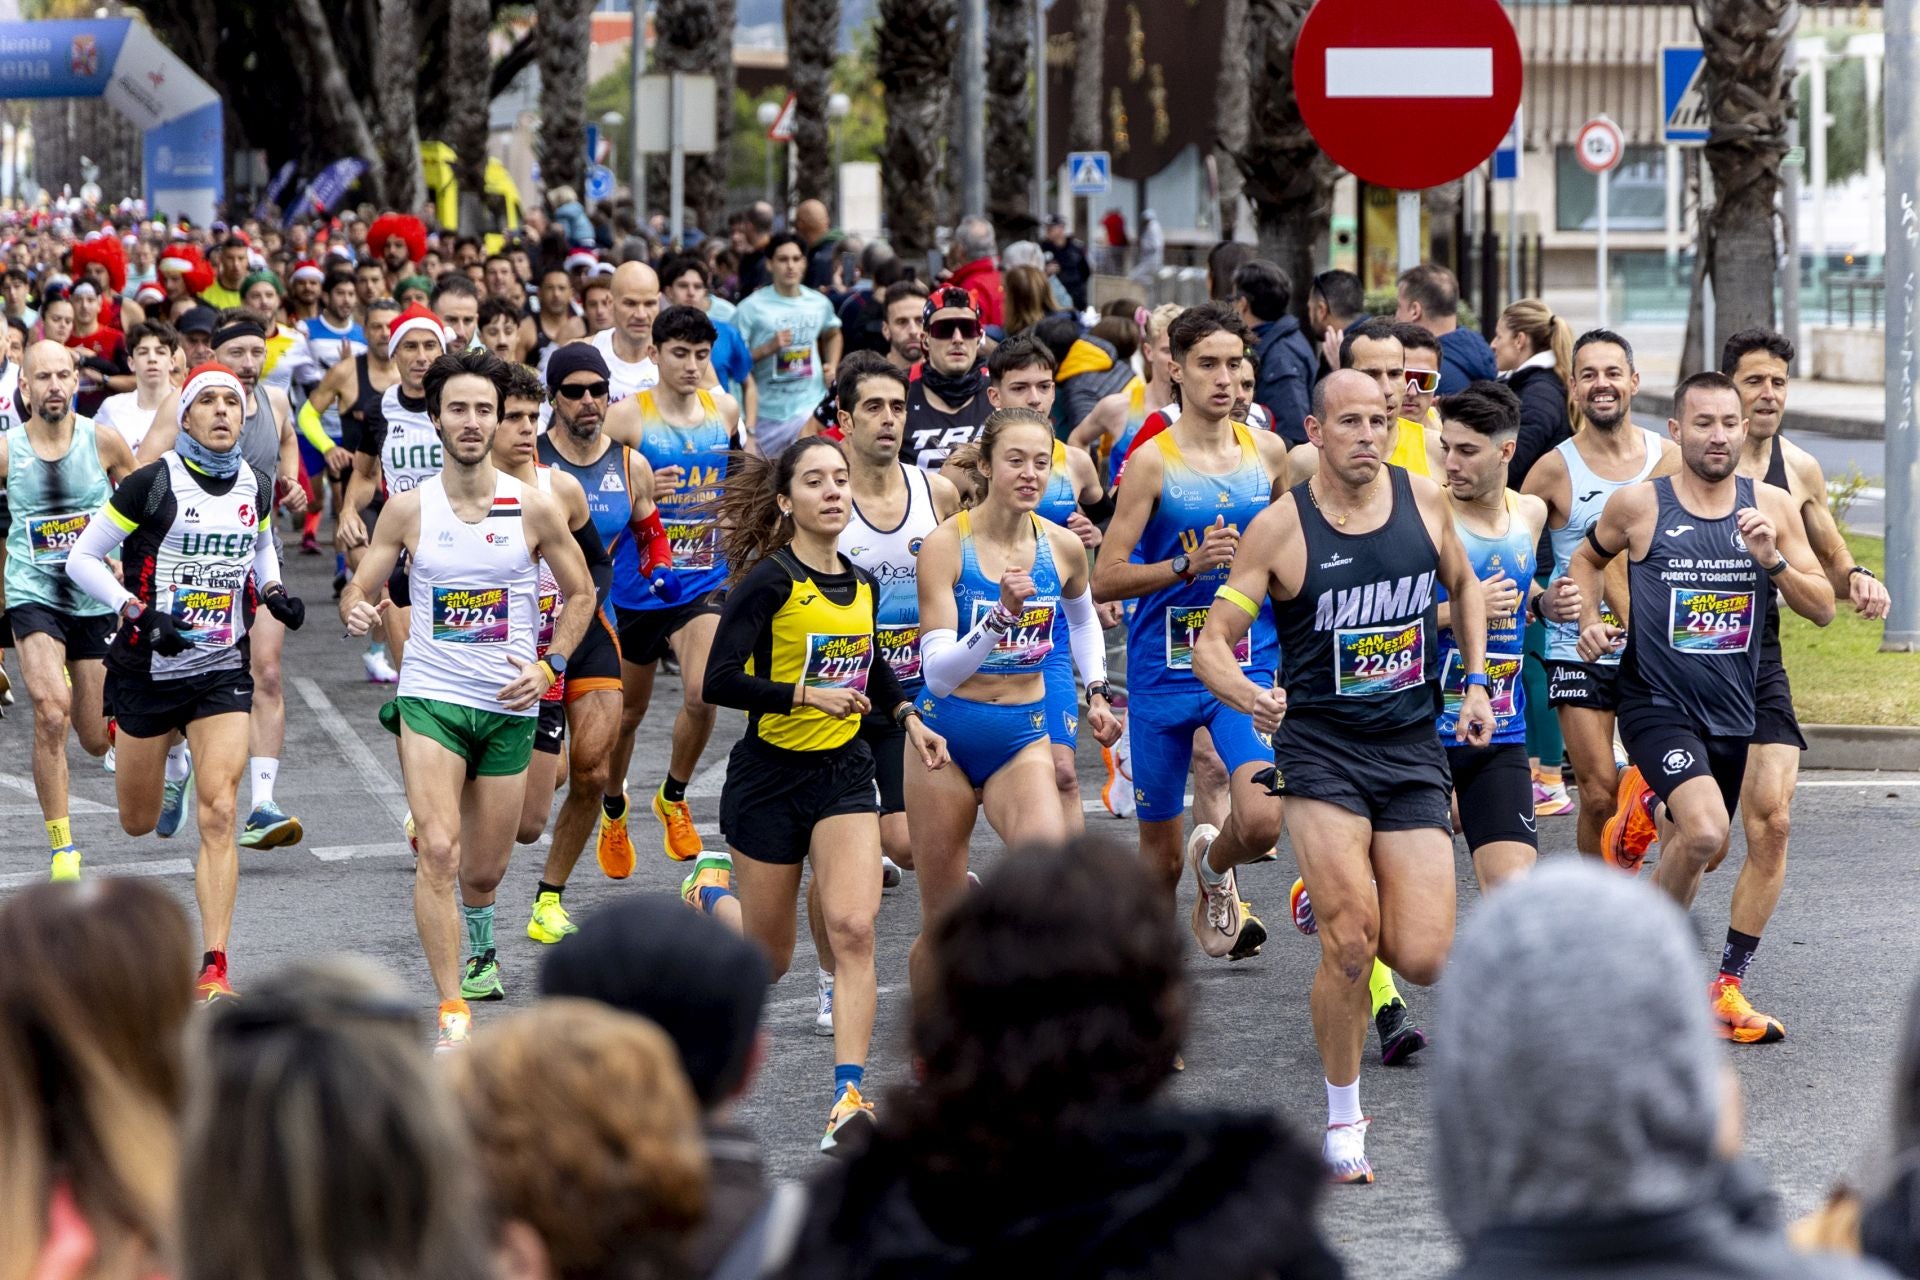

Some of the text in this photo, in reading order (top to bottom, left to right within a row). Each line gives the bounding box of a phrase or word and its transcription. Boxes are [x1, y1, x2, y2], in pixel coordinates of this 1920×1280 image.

[391, 444, 443, 469] UNE
[1668, 558, 1752, 569] CLUB ATLETISMO
[1661, 571, 1757, 582] PUERTO TORREVIEJA
[447, 591, 468, 601] SAN
[447, 589, 503, 609] SILVESTRE
[1691, 595, 1749, 613] SILVESTRE
[1692, 594, 1717, 605] SAN
[182, 606, 226, 629] 2442
[444, 607, 497, 627] 2726
[1686, 611, 1742, 632] 2965
[825, 636, 870, 657] SILVESTRE
[826, 638, 848, 650] SAN
[1358, 633, 1384, 648] SAN
[1358, 626, 1417, 656] SILVESTRE
[817, 656, 864, 678] 2727
[1354, 649, 1412, 677] 2268
[1552, 666, 1588, 682] Alma
[1549, 684, 1589, 699] Enma
